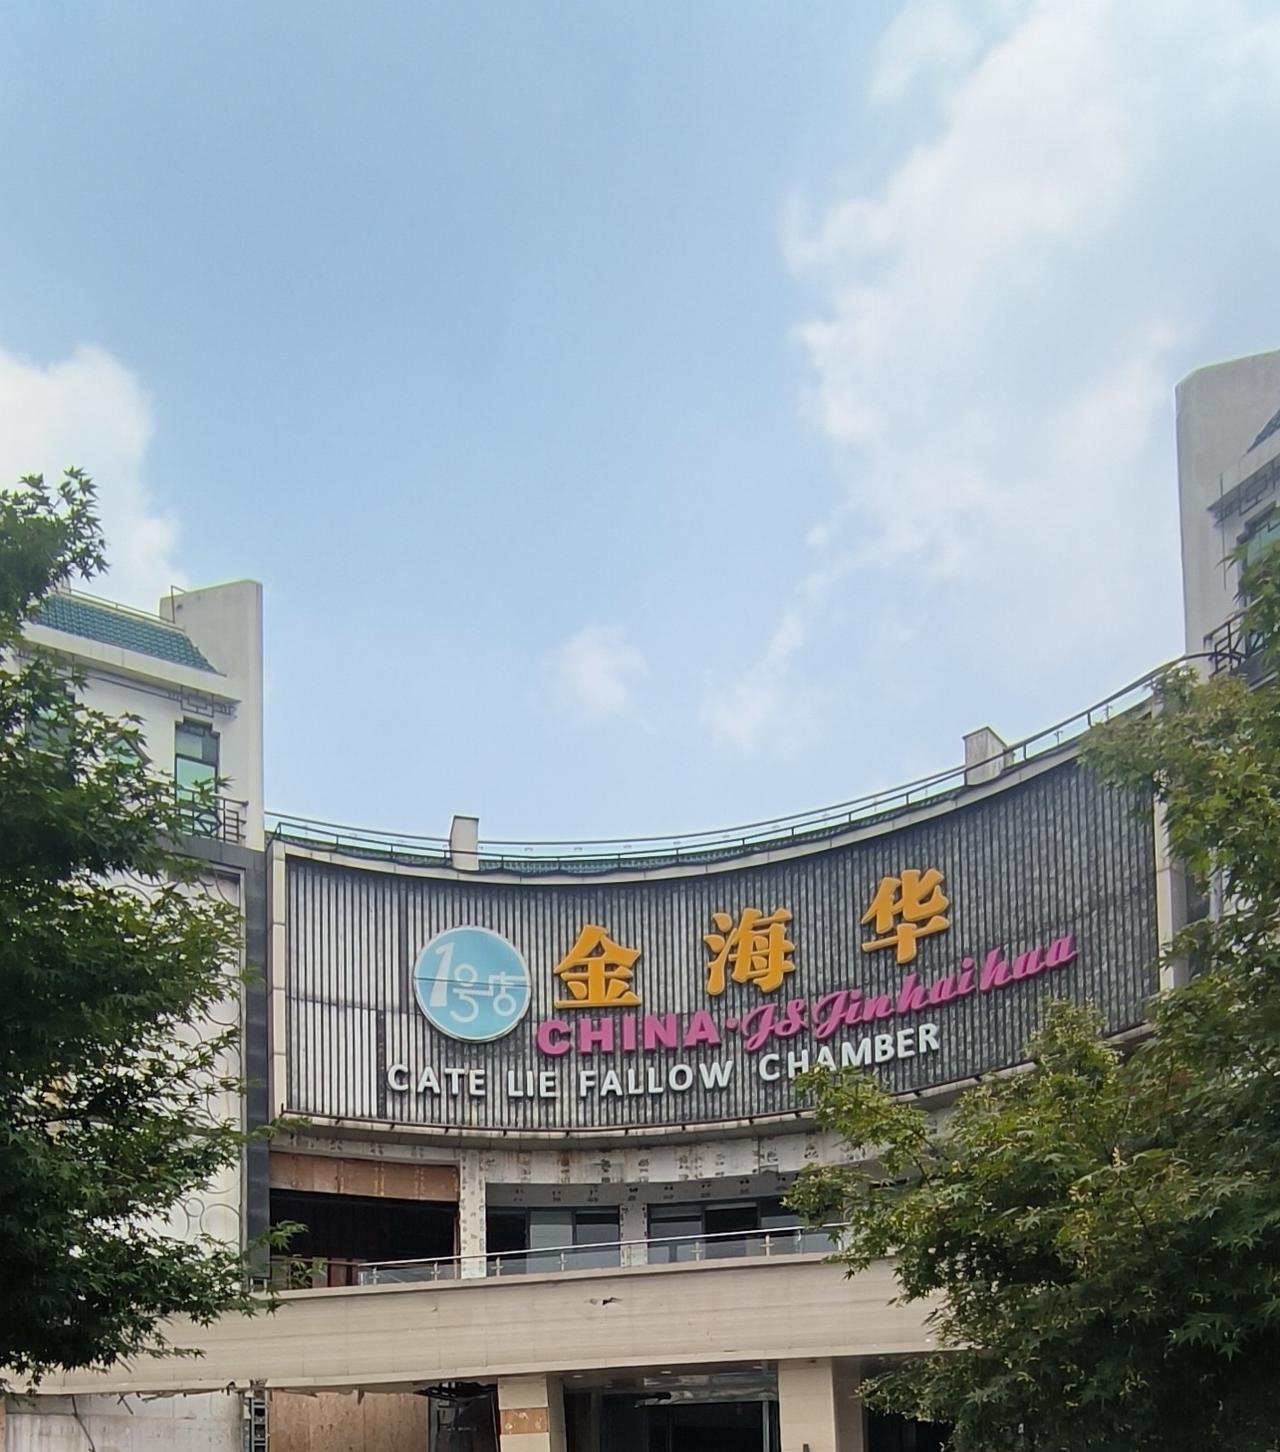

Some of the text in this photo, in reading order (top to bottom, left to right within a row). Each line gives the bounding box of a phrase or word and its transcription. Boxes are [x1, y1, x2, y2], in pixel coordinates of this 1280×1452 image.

[553, 867, 951, 1010] 金海华
[387, 1022, 940, 1098] CATE LIE FALLOW CHAMBER
